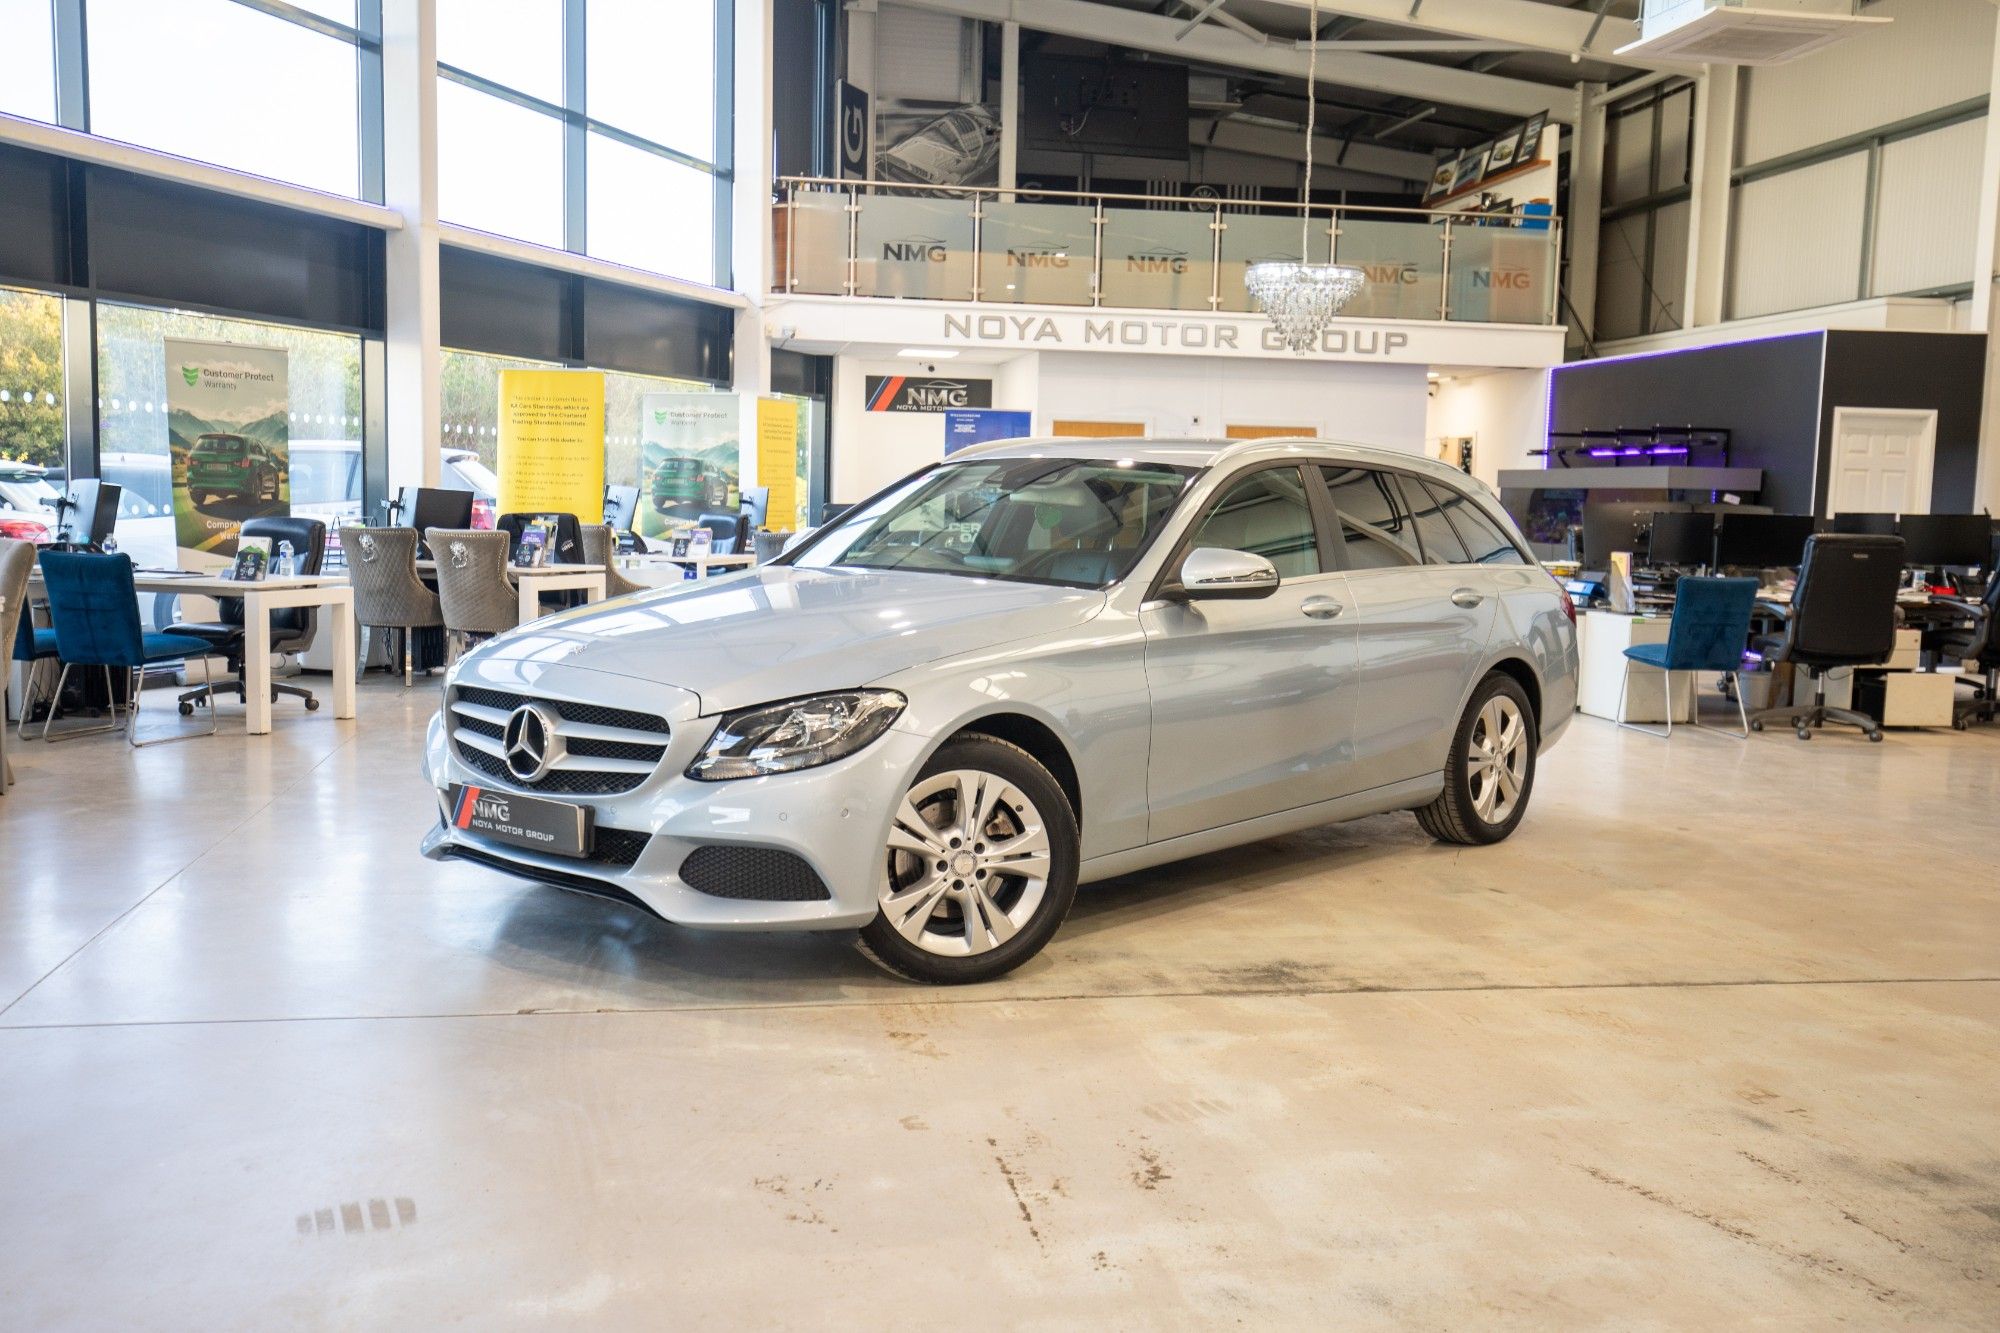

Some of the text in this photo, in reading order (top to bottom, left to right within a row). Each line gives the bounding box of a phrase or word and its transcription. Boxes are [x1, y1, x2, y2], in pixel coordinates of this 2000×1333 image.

[883, 242, 947, 263] NMG
[1007, 249, 1069, 268] NMG
[1127, 255, 1189, 274] NMG
[1473, 270, 1530, 289] NMG
[944, 313, 1062, 342] NOYA
[1085, 319, 1239, 350] MOTOR
[203, 368, 274, 382] Customer Protect
[204, 380, 237, 391] Warranty
[907, 387, 968, 407] NMG
[472, 799, 510, 822] NMG
[472, 819, 555, 842] NOYA MOTOR GROUP
